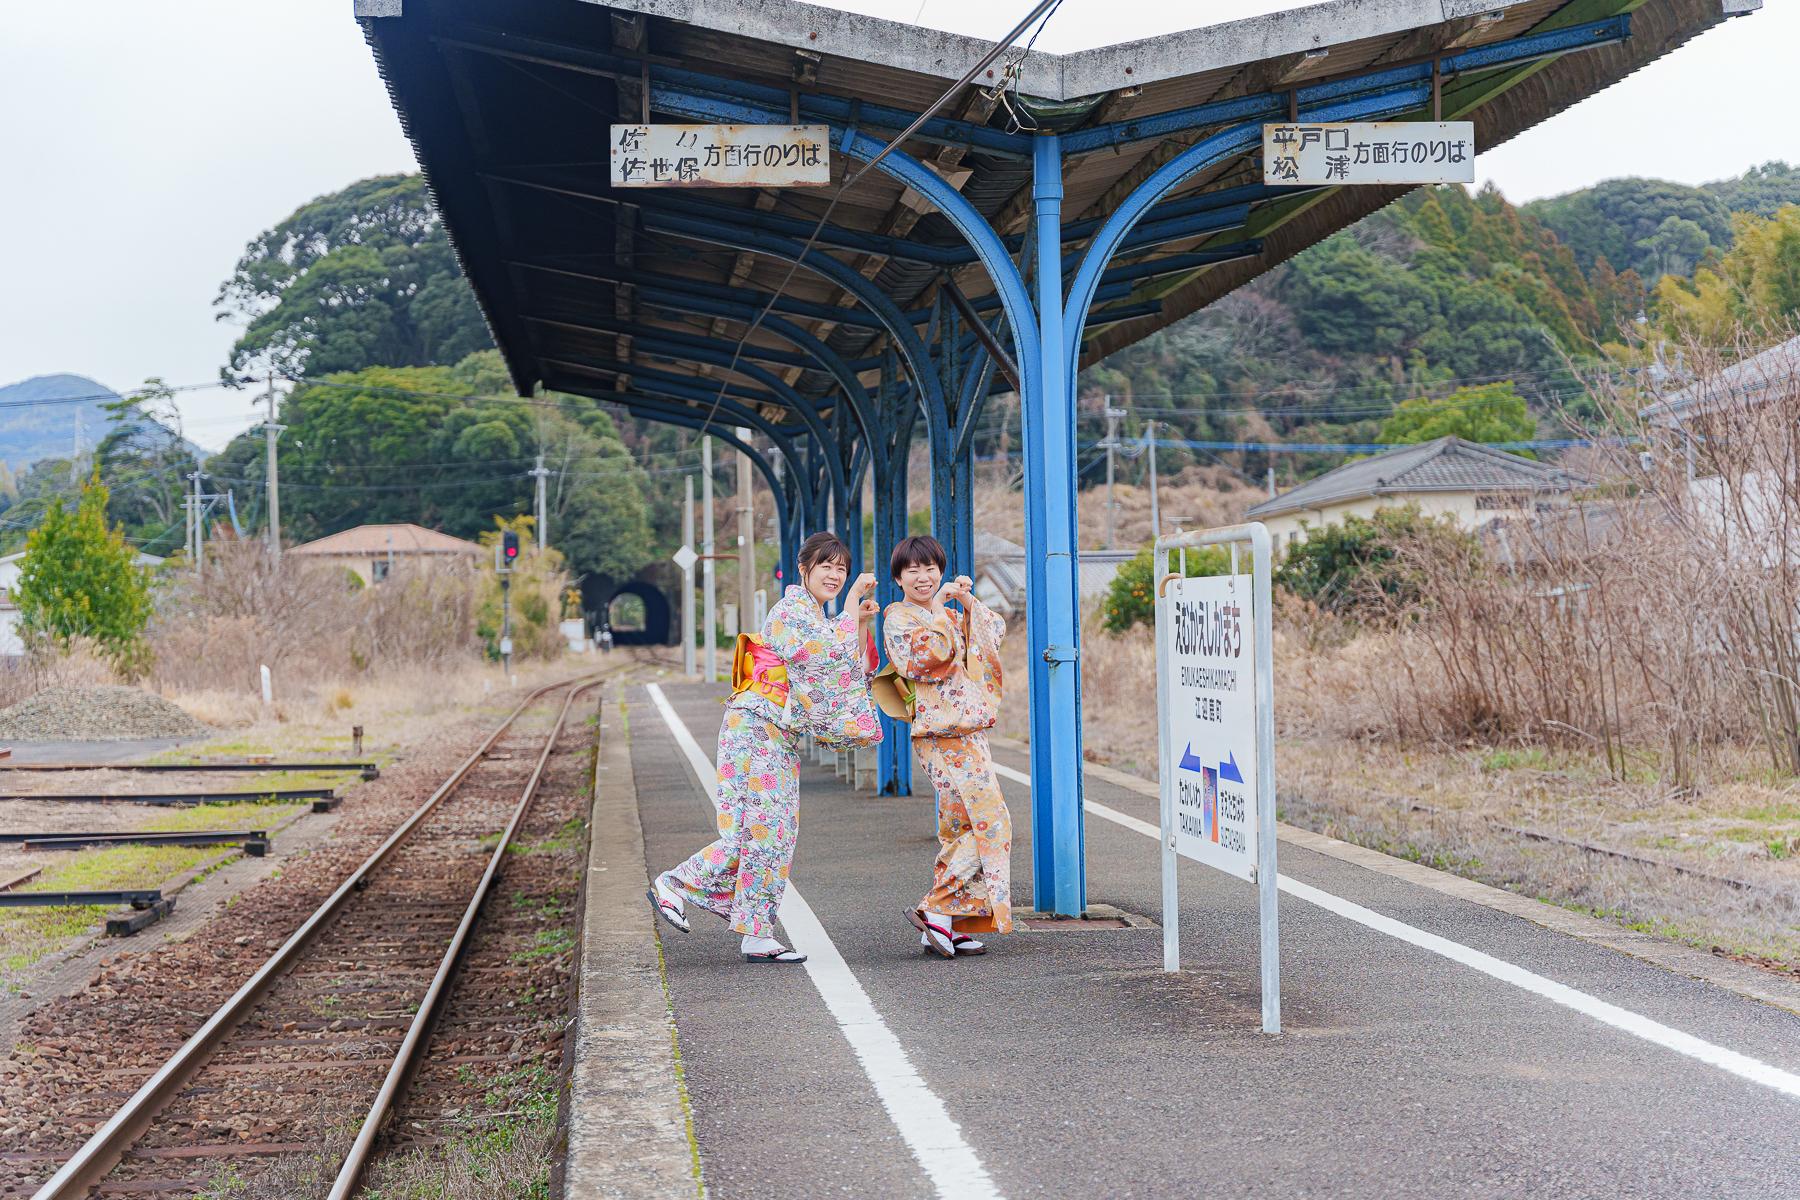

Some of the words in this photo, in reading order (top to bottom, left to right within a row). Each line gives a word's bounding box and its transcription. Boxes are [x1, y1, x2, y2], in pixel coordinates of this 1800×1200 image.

[1272, 126, 1350, 152] 平戸口
[703, 143, 822, 167] 方面行のりば
[1352, 140, 1467, 165] 方面行のりば
[1175, 600, 1241, 658] えむかえしかまち
[1181, 665, 1237, 692] EMUKAESHIKAMACHI
[1179, 778, 1202, 809] たかいわ
